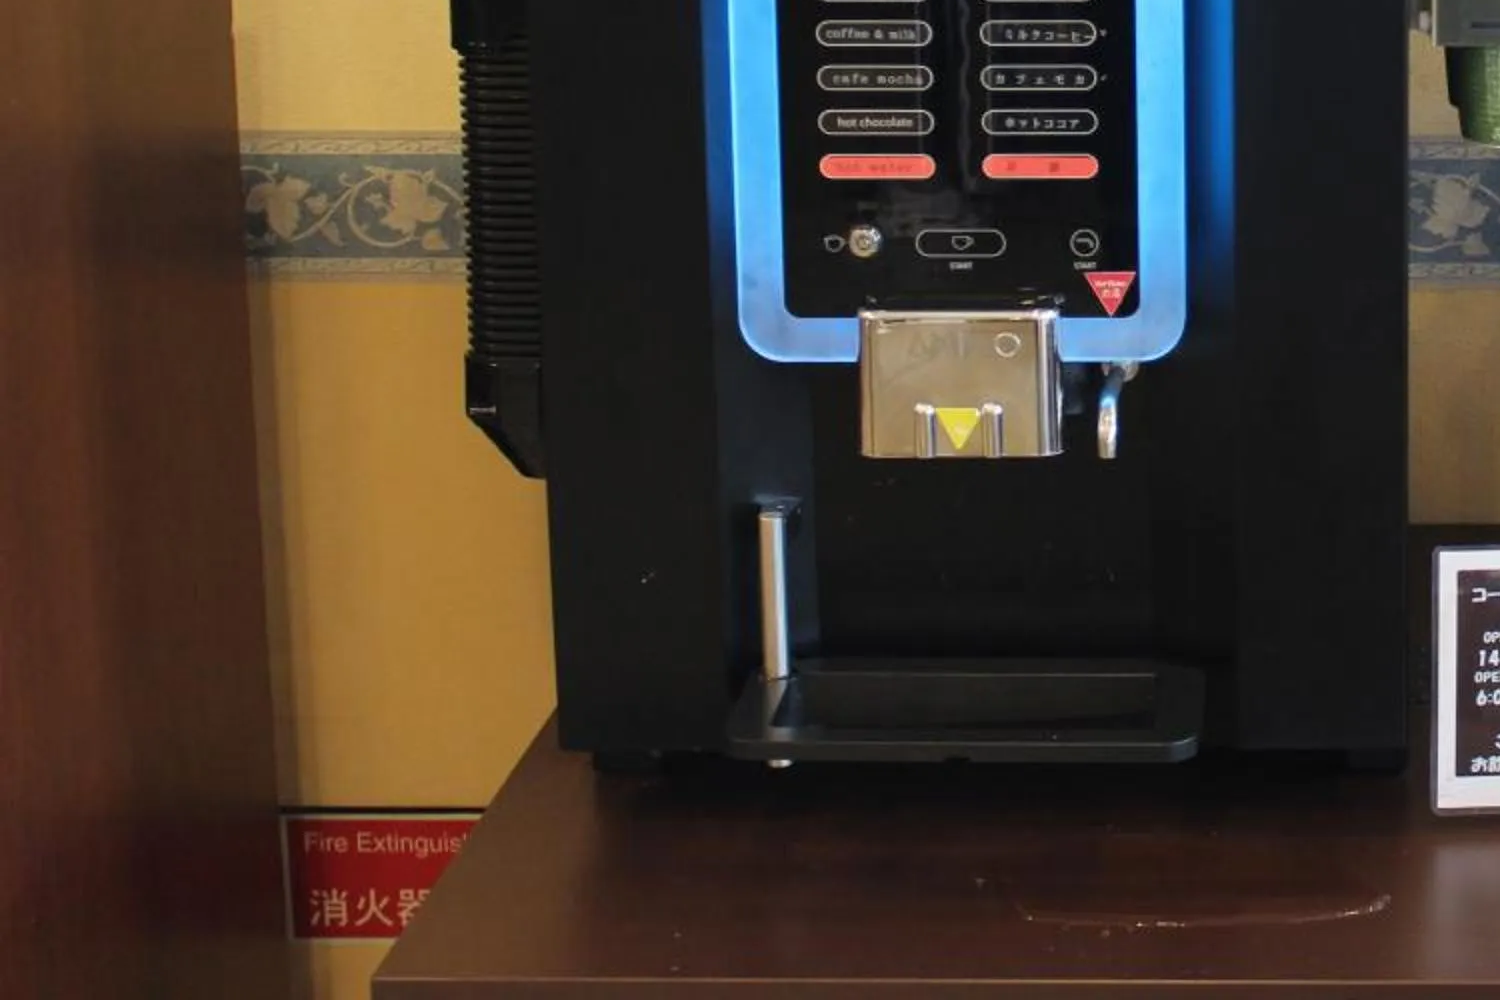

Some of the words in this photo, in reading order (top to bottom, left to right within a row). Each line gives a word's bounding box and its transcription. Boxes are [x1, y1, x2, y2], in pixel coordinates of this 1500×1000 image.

[825, 27, 870, 39] coffee
[837, 115, 858, 128] hot
[859, 115, 914, 128] chocolate
[304, 832, 348, 853] Fire
[357, 831, 468, 858] Extinguis
